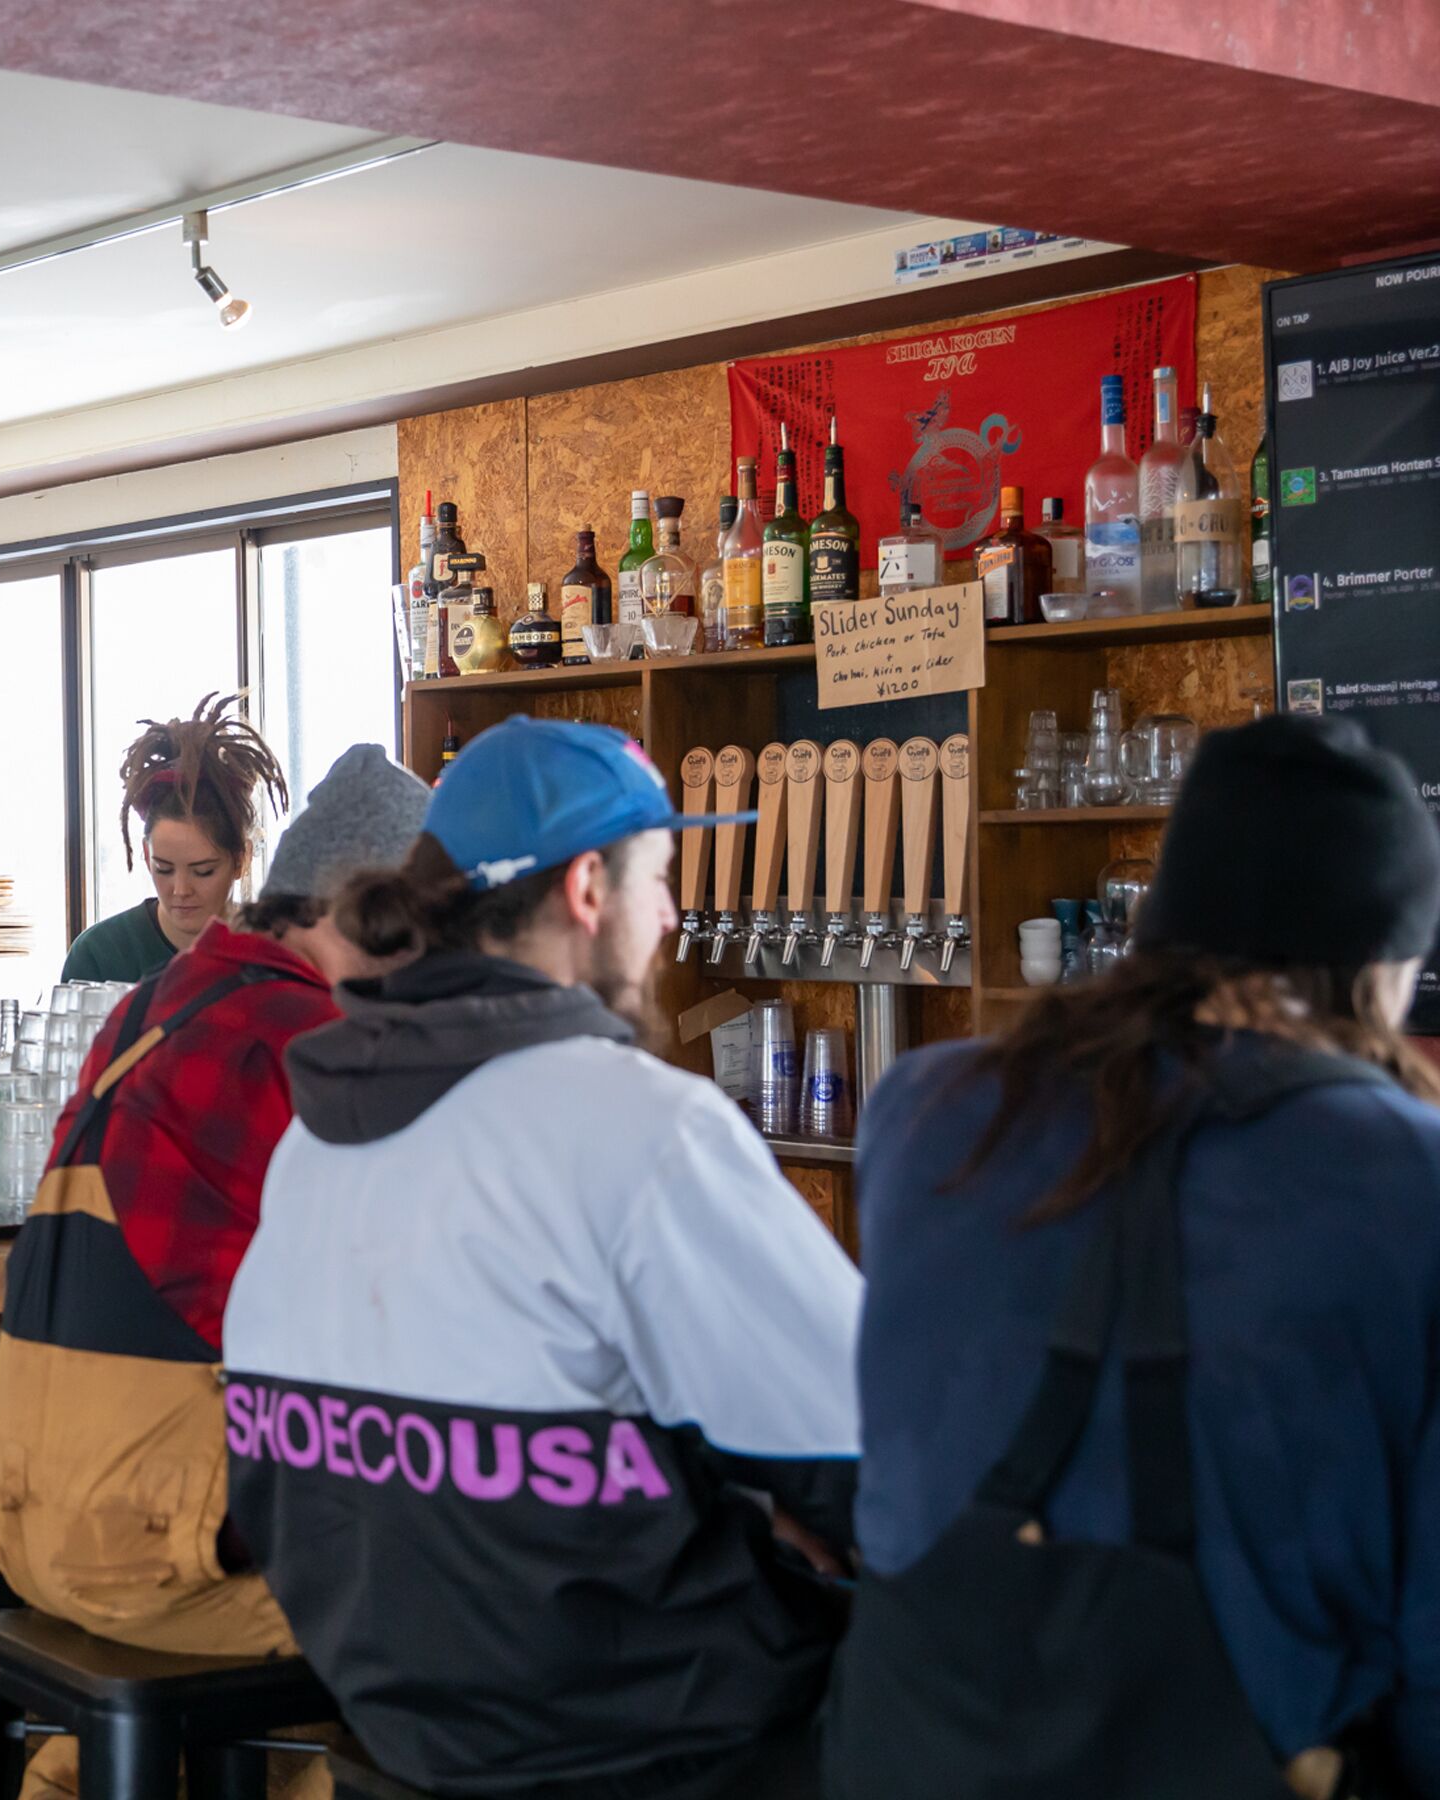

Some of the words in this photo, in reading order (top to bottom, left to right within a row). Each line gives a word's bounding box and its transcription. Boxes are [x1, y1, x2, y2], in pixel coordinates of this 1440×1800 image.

[1376, 273, 1403, 288] NOW
[1277, 317, 1290, 328] ON
[1292, 314, 1309, 324] TAP
[886, 338, 947, 364] SHIGA
[949, 325, 1016, 353] KOGEN
[923, 352, 977, 381] IPA
[1316, 364, 1326, 375] 1.
[1328, 358, 1350, 374] AJB
[1352, 357, 1372, 371] Joy
[1375, 351, 1406, 368] Juice
[1331, 464, 1389, 480] Tamamura
[1391, 458, 1433, 473] Honten
[1337, 571, 1391, 587] Brimmer
[1394, 567, 1434, 581] Porter
[854, 637, 896, 653] Chicken
[904, 634, 914, 643] or
[921, 627, 946, 641] Tofu
[912, 663, 921, 673] or
[877, 680, 919, 697] ¥1200
